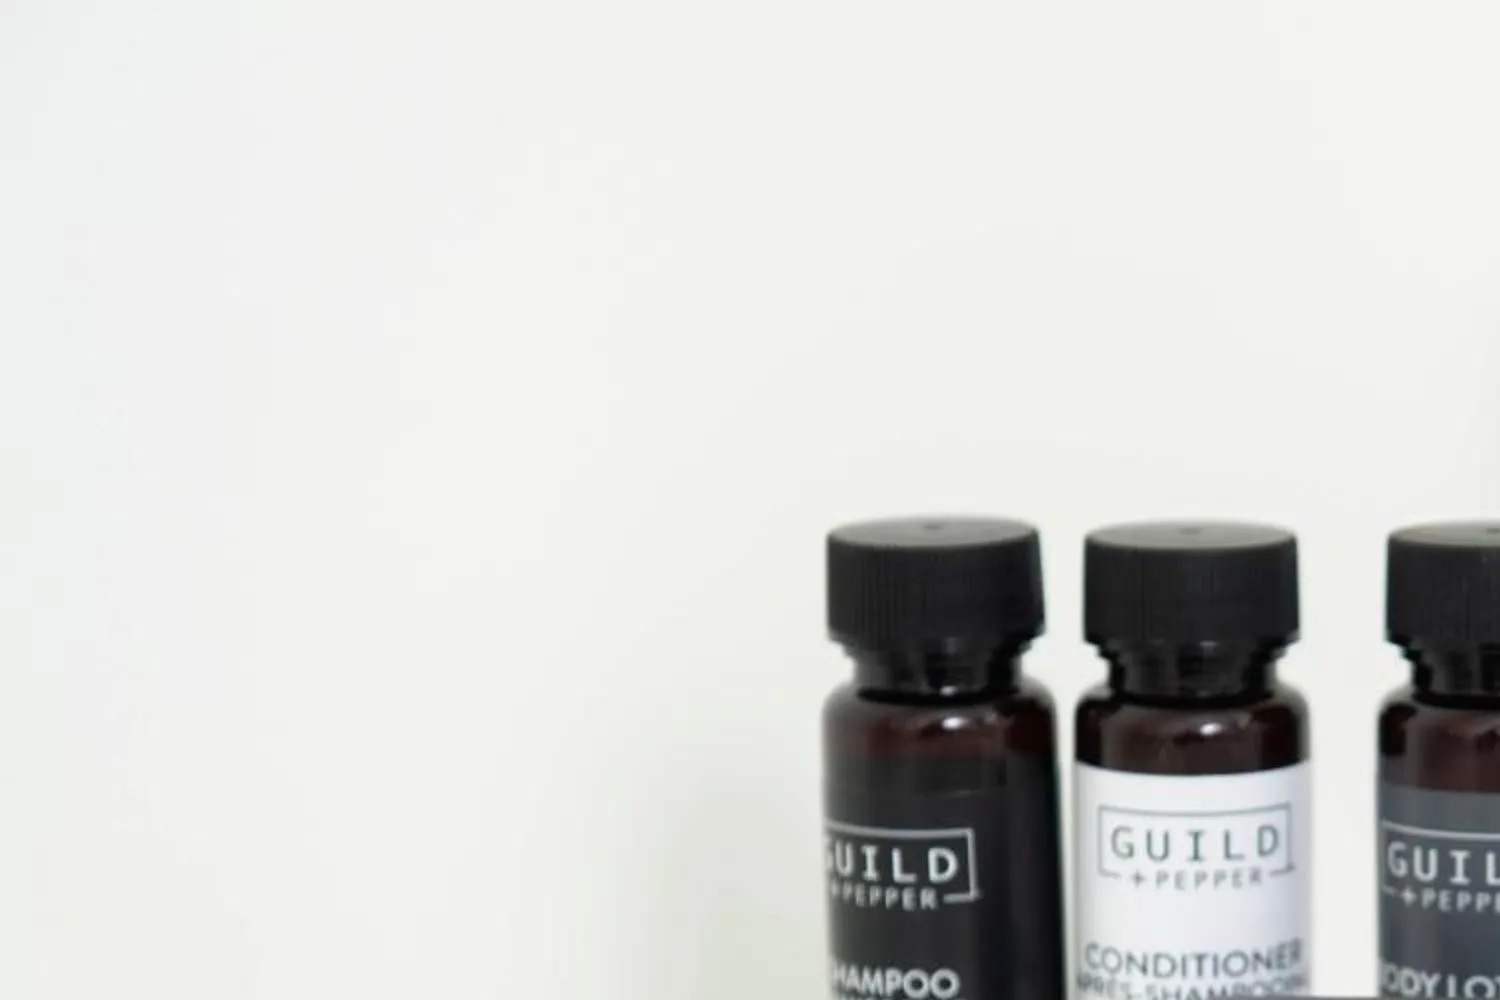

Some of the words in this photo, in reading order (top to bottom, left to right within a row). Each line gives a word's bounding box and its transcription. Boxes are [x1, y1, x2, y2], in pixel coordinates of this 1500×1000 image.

[1110, 825, 1280, 862] GUILD
[1085, 937, 1304, 979] CONDITIONER
[834, 962, 960, 1000] HAMPOO
[1382, 962, 1441, 998] ODY
